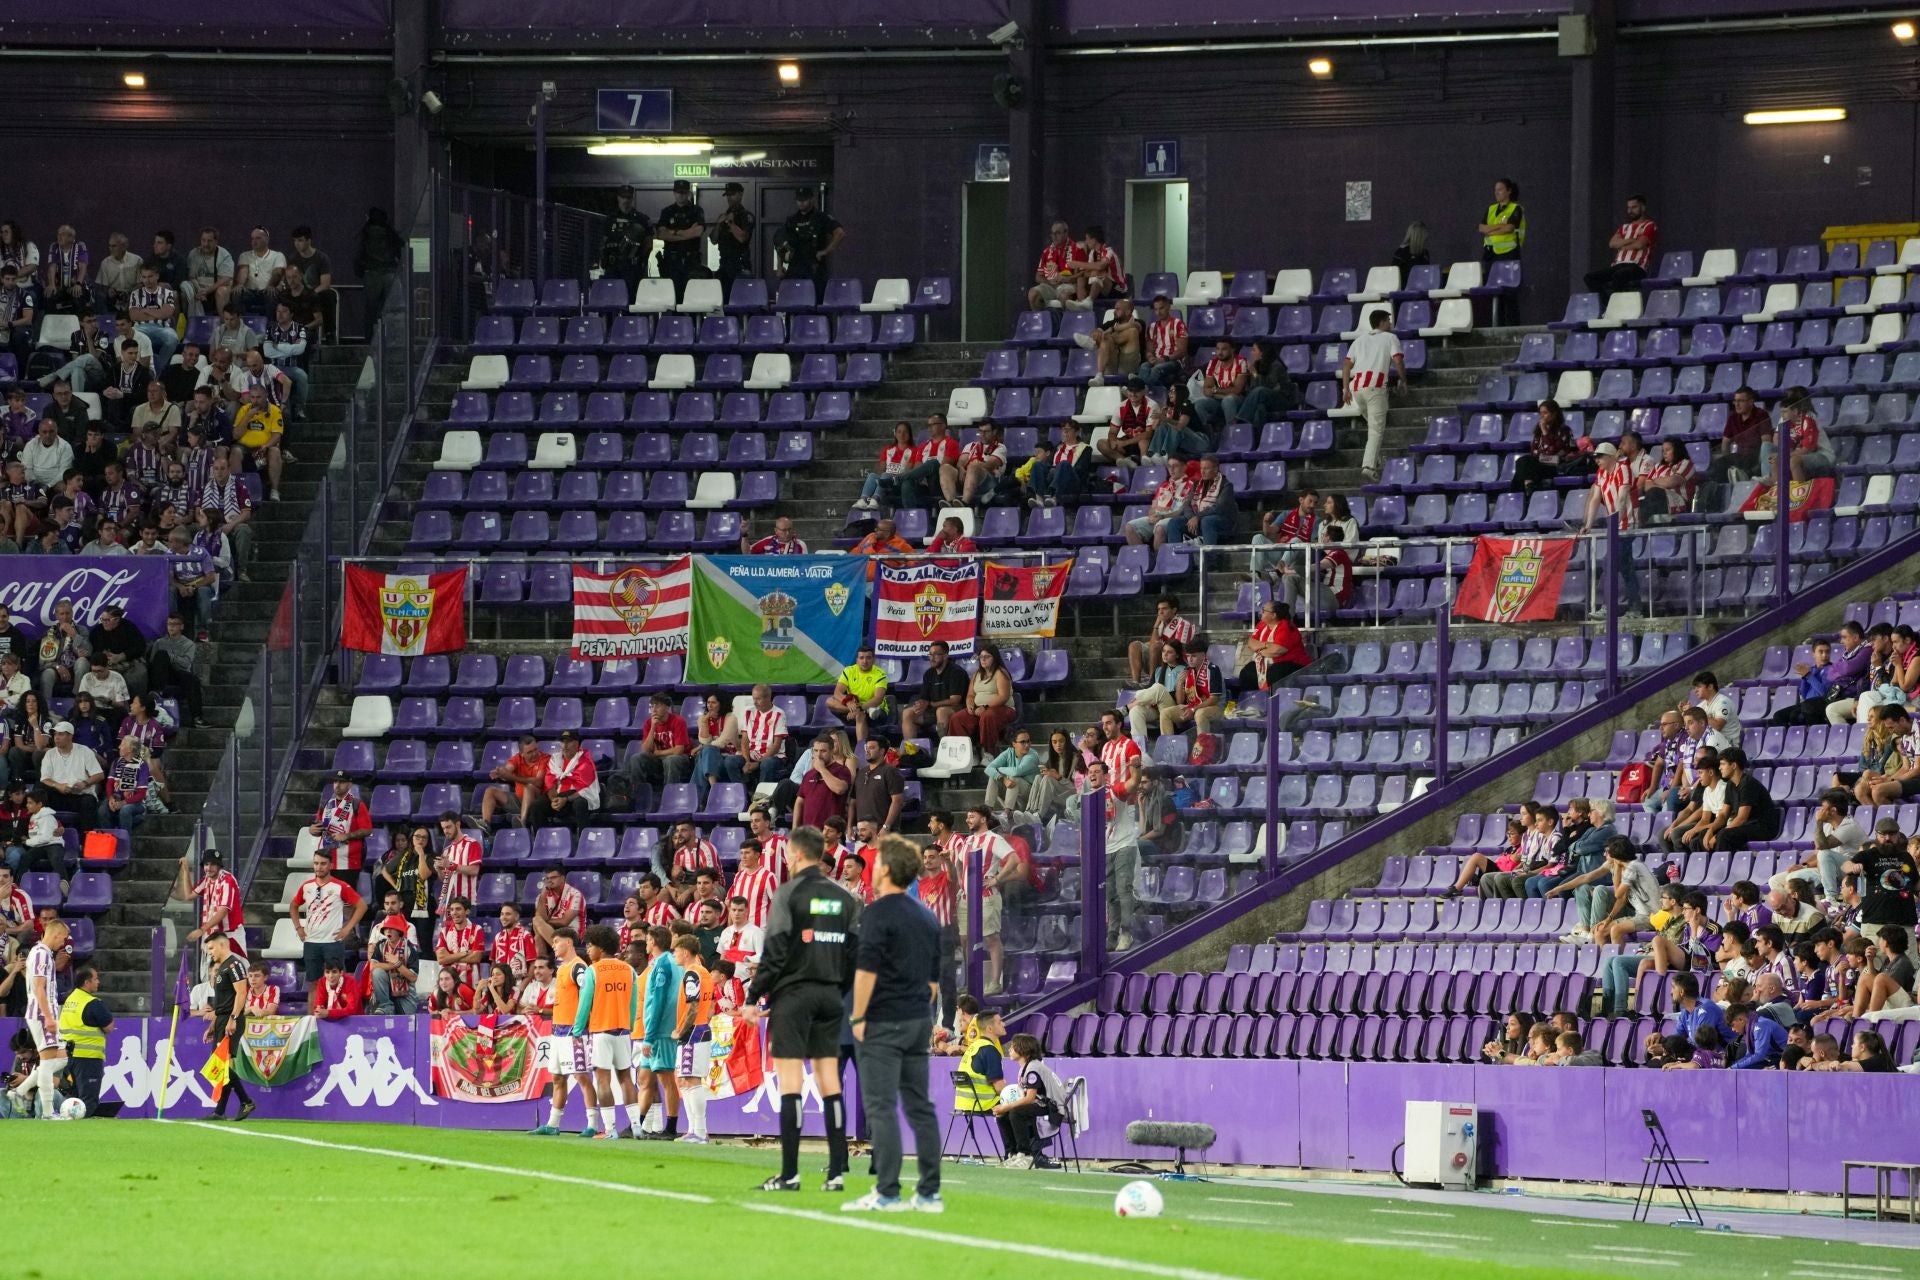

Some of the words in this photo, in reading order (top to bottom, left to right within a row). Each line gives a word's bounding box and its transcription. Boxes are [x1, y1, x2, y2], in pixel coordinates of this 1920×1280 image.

[627, 94, 643, 126] 7
[750, 159, 817, 168] VISITANTE
[677, 166, 708, 176] SALIDA
[729, 564, 750, 577] PEÑA
[751, 566, 766, 577] U.D.
[767, 565, 800, 577] ALMERÍA
[805, 566, 833, 578] VIATOR
[882, 567, 912, 581] U.D.
[914, 566, 976, 581] ALMERIA
[386, 594, 398, 603] U
[416, 594, 428, 603] D
[990, 605, 1001, 614] NO
[1003, 605, 1031, 614] SOPLA
[1033, 602, 1055, 611] VIENT
[1013, 617, 1034, 627] QUE
[580, 638, 617, 656] PEÑA
[621, 633, 689, 656] MILHOJAS
[878, 643, 917, 653] ORGULLO
[919, 642, 972, 653] ROANCO
[121, 767, 137, 790] REAL
[605, 982, 627, 992] DIGI
[252, 1024, 263, 1034] U
[281, 1024, 292, 1033] D
[249, 1039, 287, 1047] ALMERI
